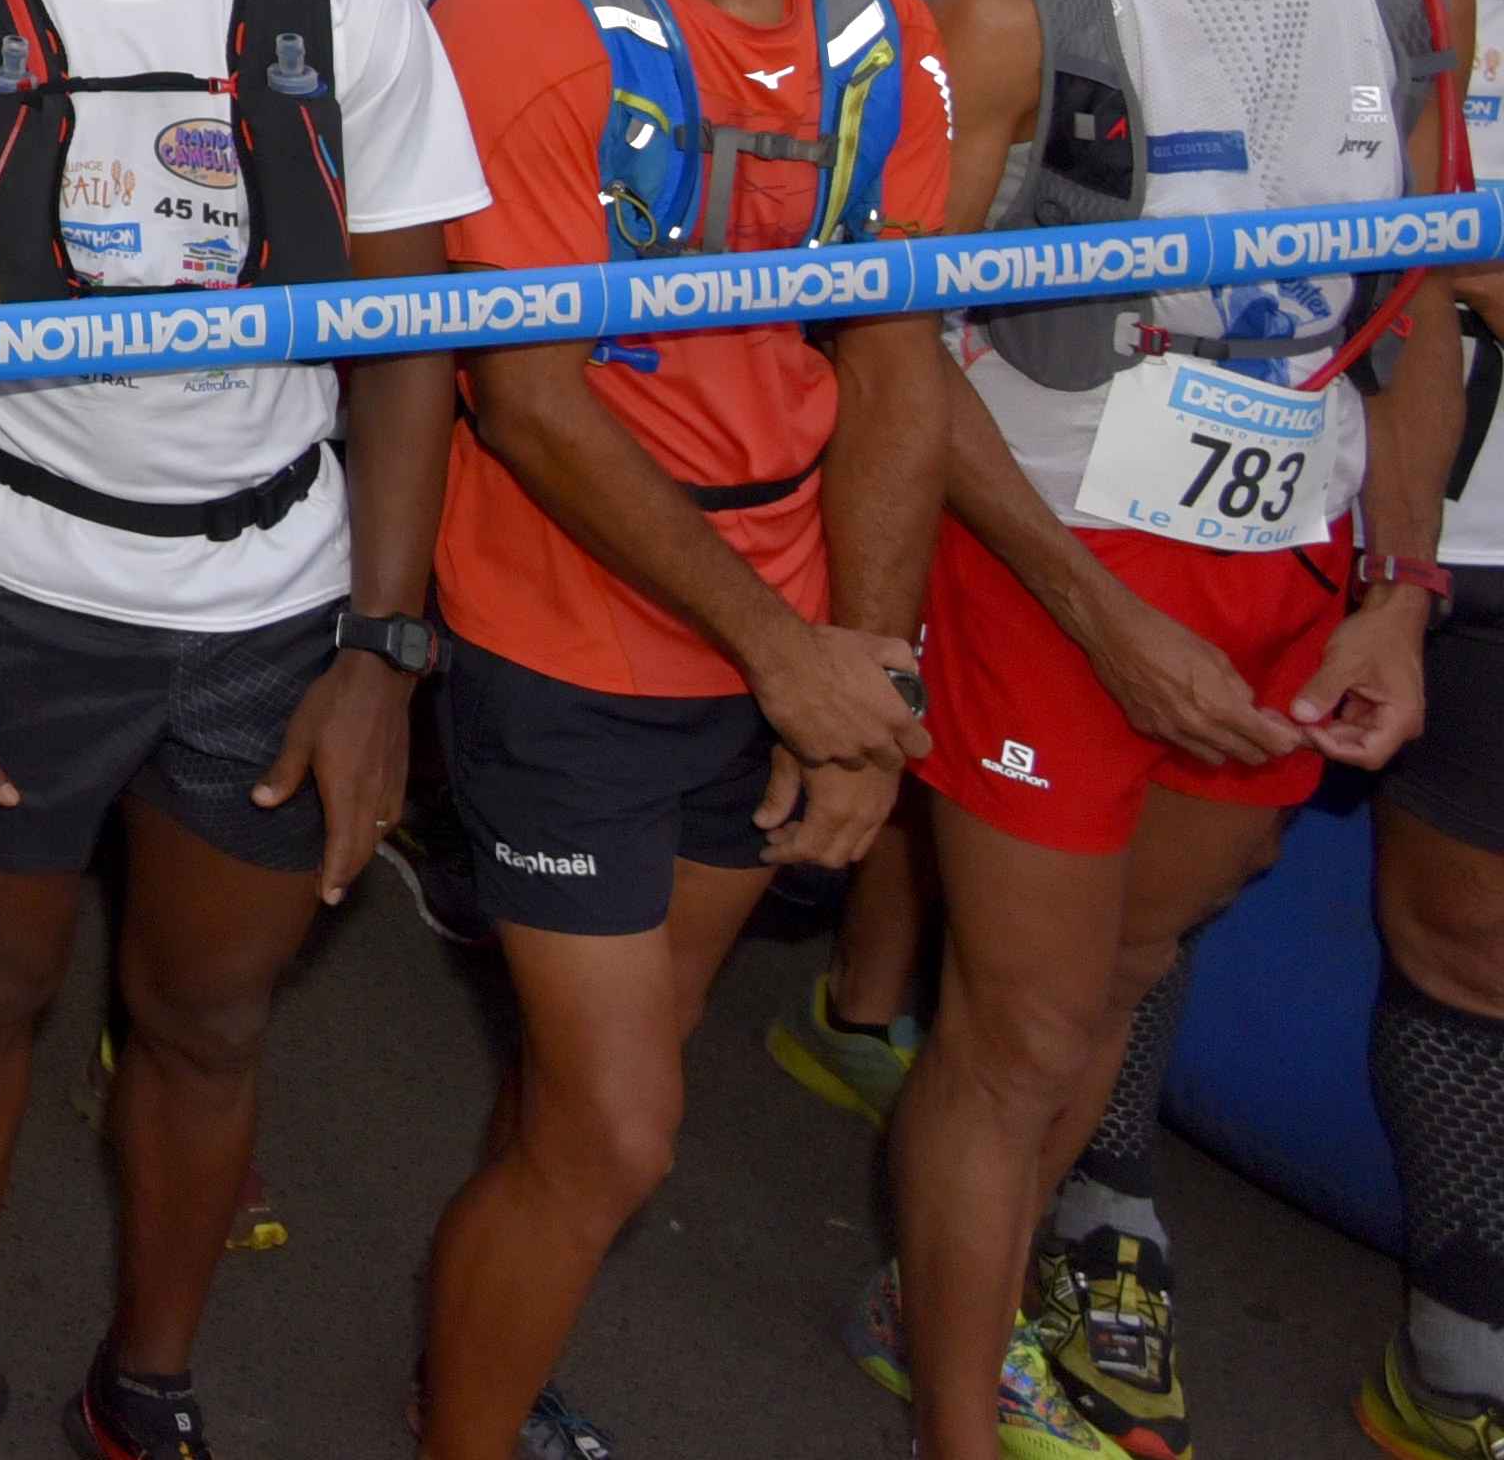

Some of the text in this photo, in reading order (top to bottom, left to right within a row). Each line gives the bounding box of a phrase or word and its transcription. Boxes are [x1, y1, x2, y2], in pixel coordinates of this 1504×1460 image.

[153, 197, 192, 220] 45
[937, 234, 1189, 295] DECATHLON
[1235, 208, 1481, 272] DECATHLON
[317, 281, 581, 342] DECATHLON
[630, 257, 889, 320] DECATHLON
[1197, 420, 1248, 440] FOND
[1179, 432, 1306, 522] 783
[1127, 499, 1171, 527] Le
[494, 840, 597, 877] Raphaël
